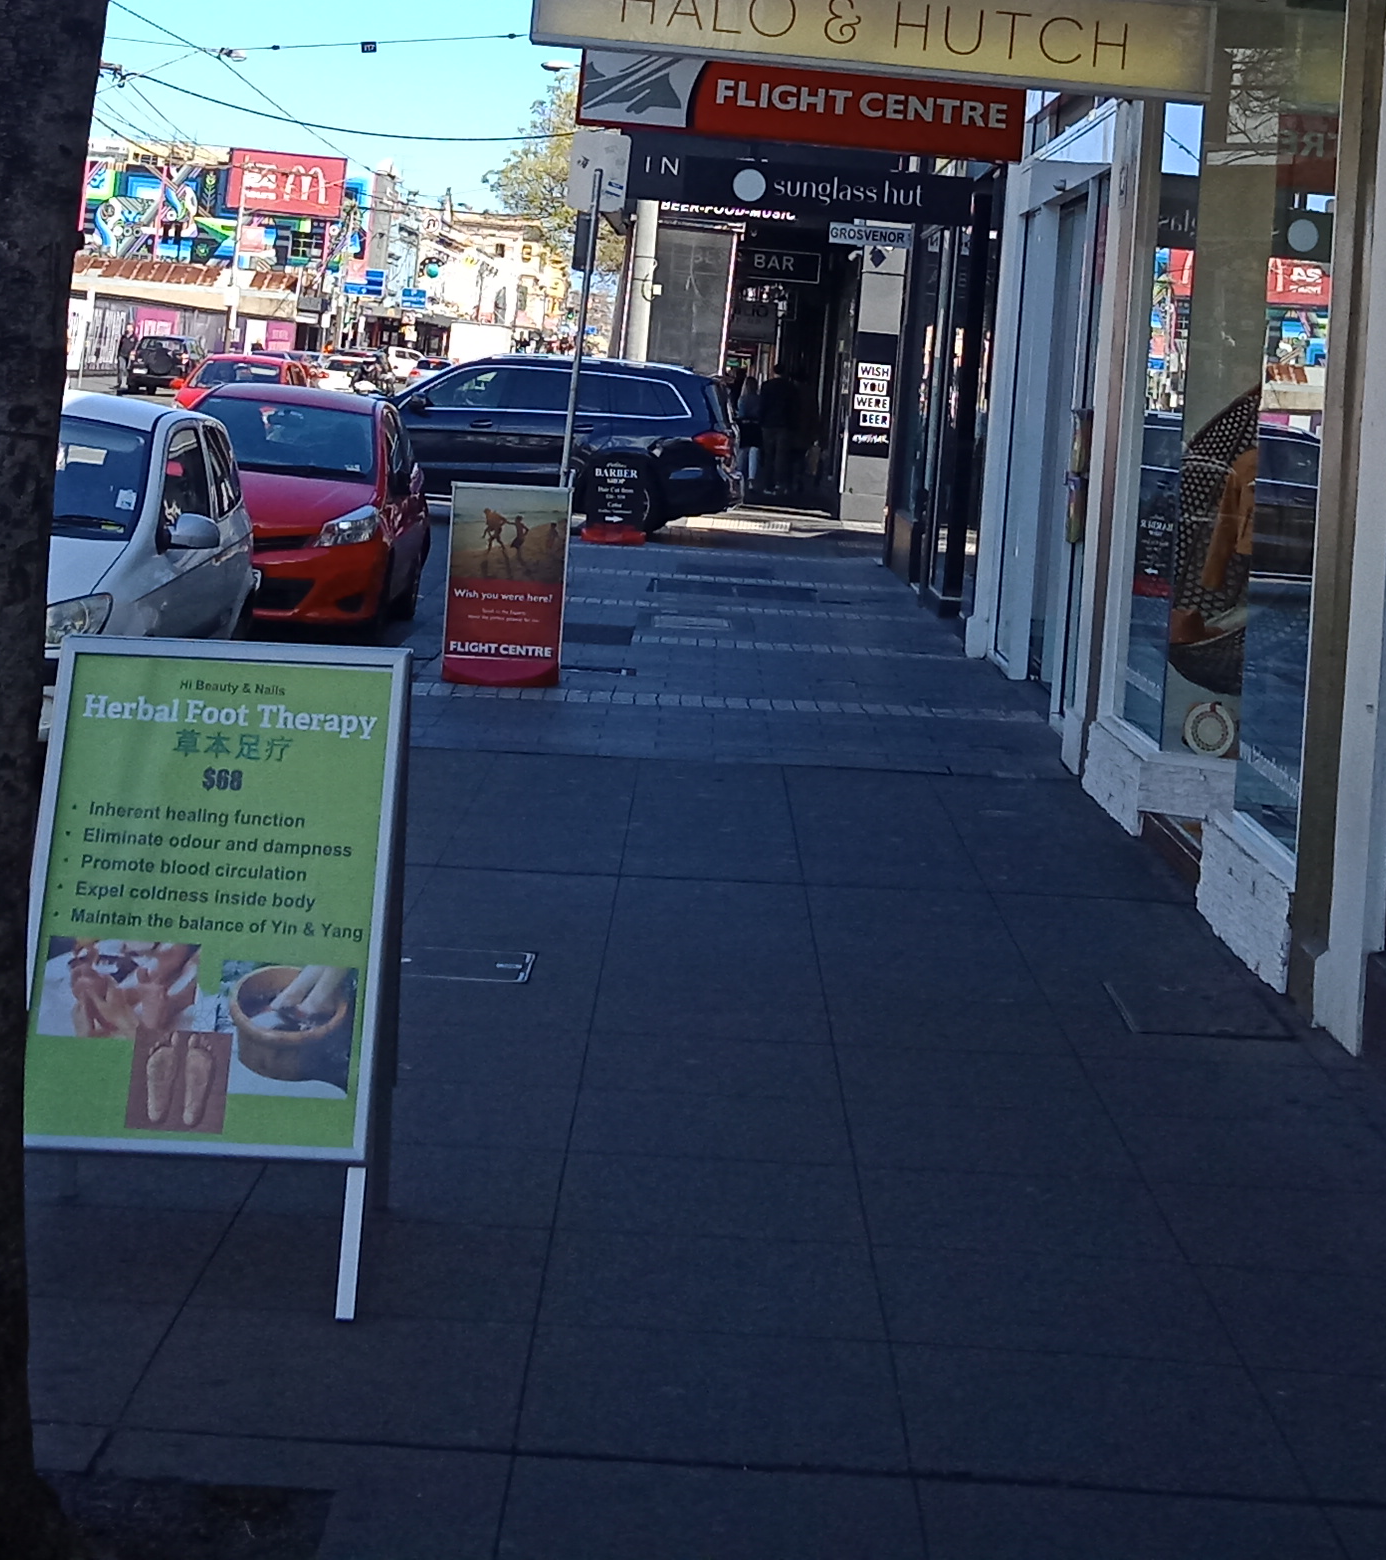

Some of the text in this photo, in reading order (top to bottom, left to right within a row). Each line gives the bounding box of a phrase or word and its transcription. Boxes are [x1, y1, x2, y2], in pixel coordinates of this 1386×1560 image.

[893, 3, 1129, 70] HUTCH
[715, 78, 1008, 130] FLIGHT CENTRE
[774, 176, 923, 207] sunglass hut
[830, 226, 905, 243] GROSVENOR
[754, 254, 794, 271] BAR
[861, 366, 889, 377] WISH
[863, 382, 885, 392] YOU
[856, 398, 887, 408] WERE
[863, 414, 887, 425] BEER
[595, 468, 637, 478] BARBER
[454, 589, 478, 598] Wish
[527, 594, 552, 602] here!
[450, 641, 552, 657] FLIGHT CENTRE
[180, 679, 286, 696] Hi Beauty & Nails
[83, 694, 377, 739] Herbal Foot Therapy
[173, 730, 293, 762] 草本足疗
[203, 767, 243, 791] $68
[89, 802, 305, 829] Inherent healing function
[84, 828, 352, 859] Eliminate odour and dampness
[81, 855, 307, 882] Promote blood circulation
[75, 881, 315, 911] Expel coldness inside body
[71, 909, 363, 942] Maintain the balance of Yin & Yang
